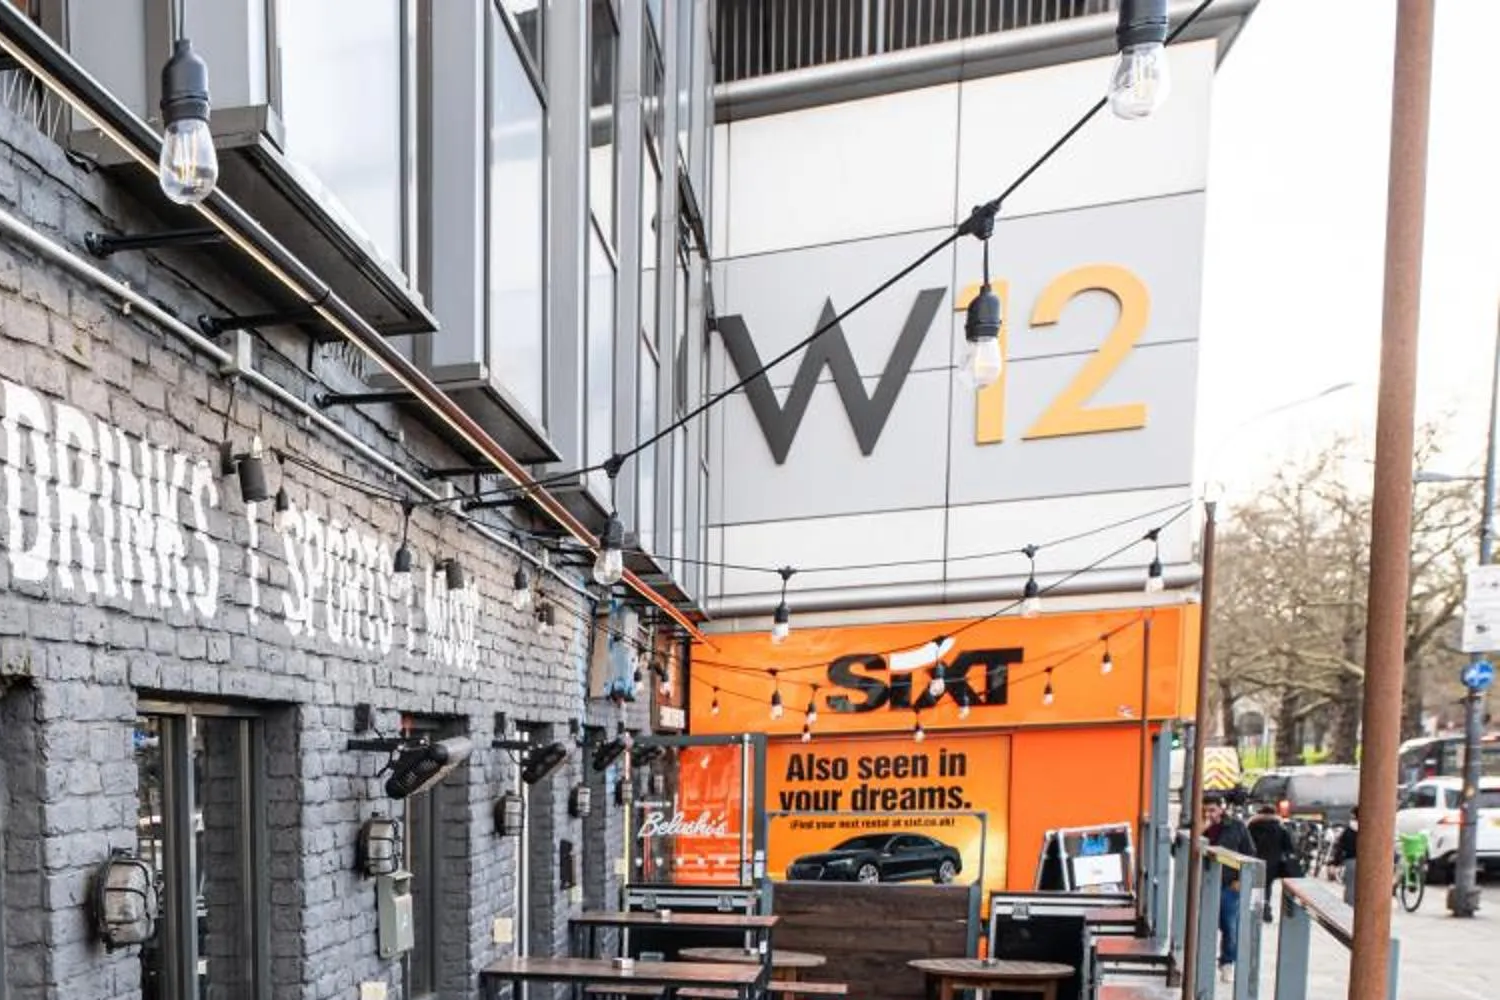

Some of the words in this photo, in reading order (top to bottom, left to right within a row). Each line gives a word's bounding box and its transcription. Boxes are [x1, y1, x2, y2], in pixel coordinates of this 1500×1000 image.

[717, 263, 1152, 466] W12
[2, 380, 220, 620] DRINKS
[281, 502, 394, 655] SPORTS
[779, 788, 842, 816] your
[851, 784, 972, 811] dreams.
[786, 753, 849, 782] Also
[857, 754, 929, 780] seen
[938, 747, 967, 778] in
